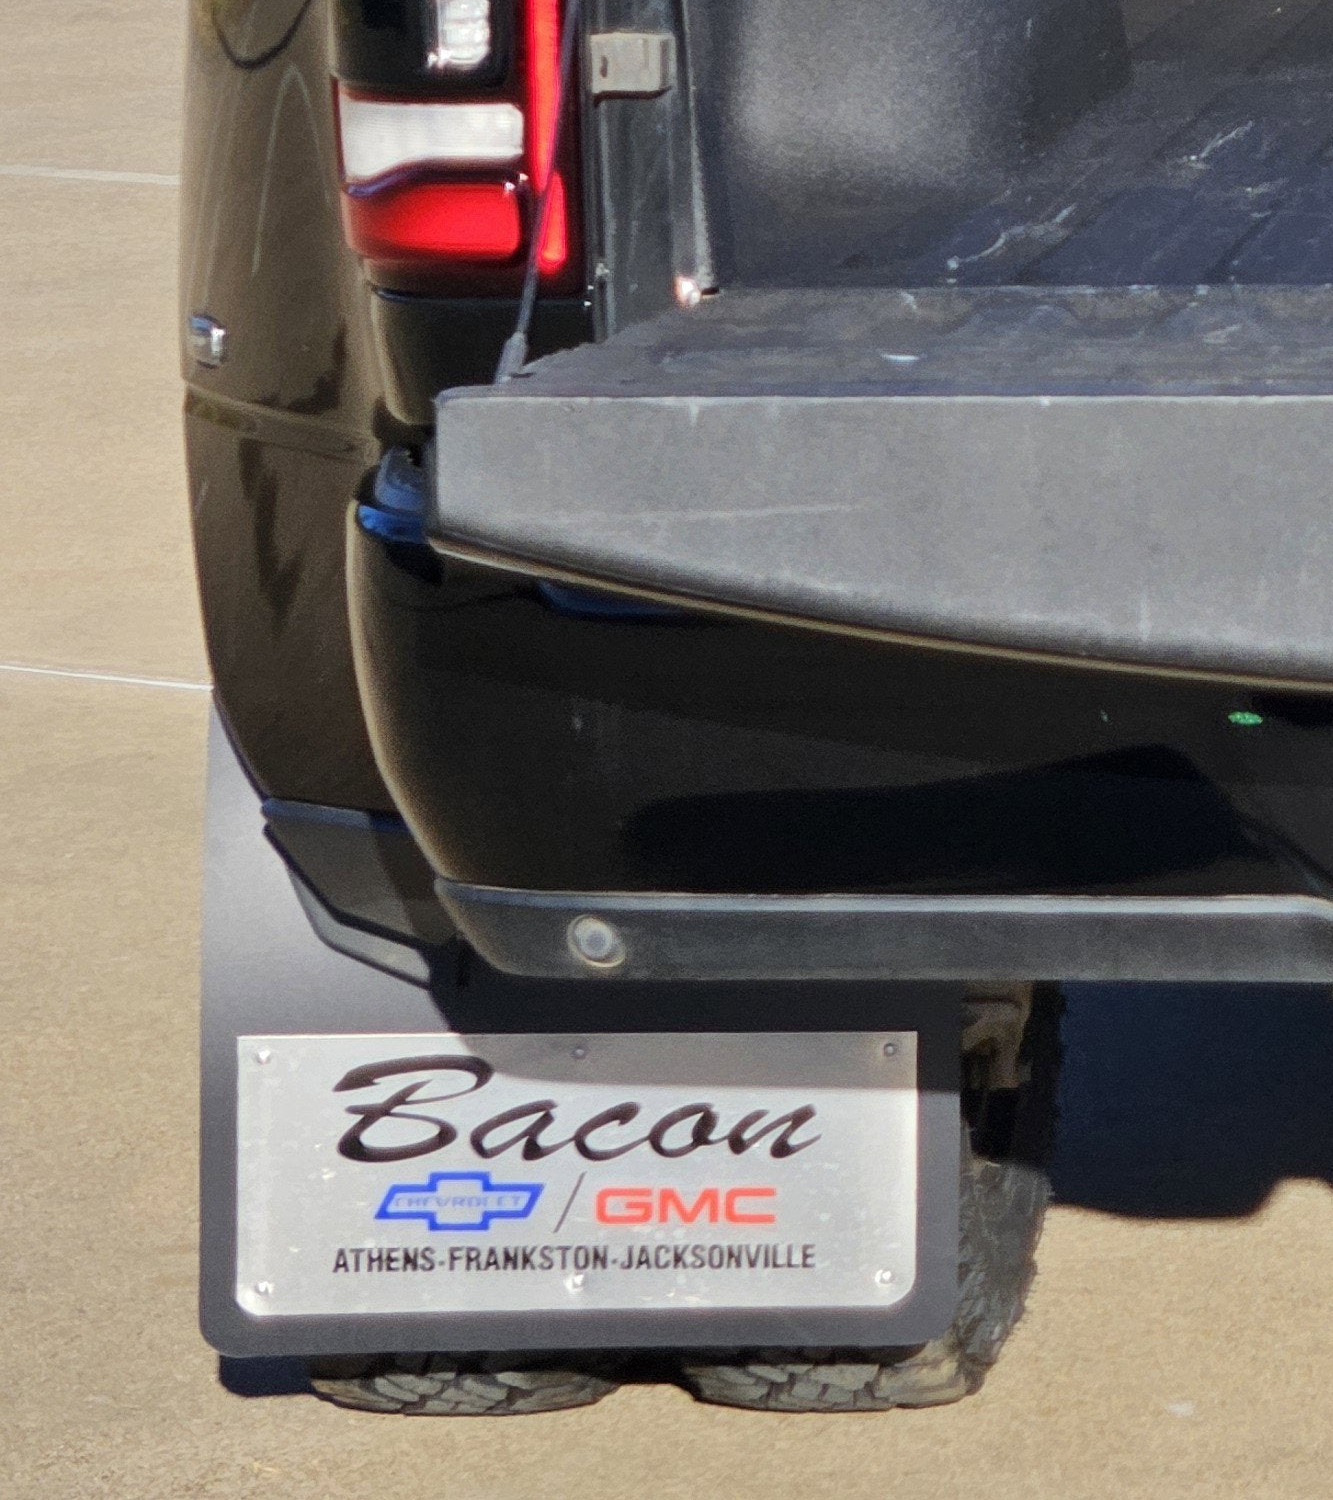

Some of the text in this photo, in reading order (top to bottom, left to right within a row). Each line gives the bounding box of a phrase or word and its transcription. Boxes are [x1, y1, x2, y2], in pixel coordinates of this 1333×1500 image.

[333, 1053, 822, 1162] Bacon
[595, 1186, 777, 1225] GMC
[332, 1243, 817, 1274] ATHENS-FRANKSTON-JACKSONVILLE
